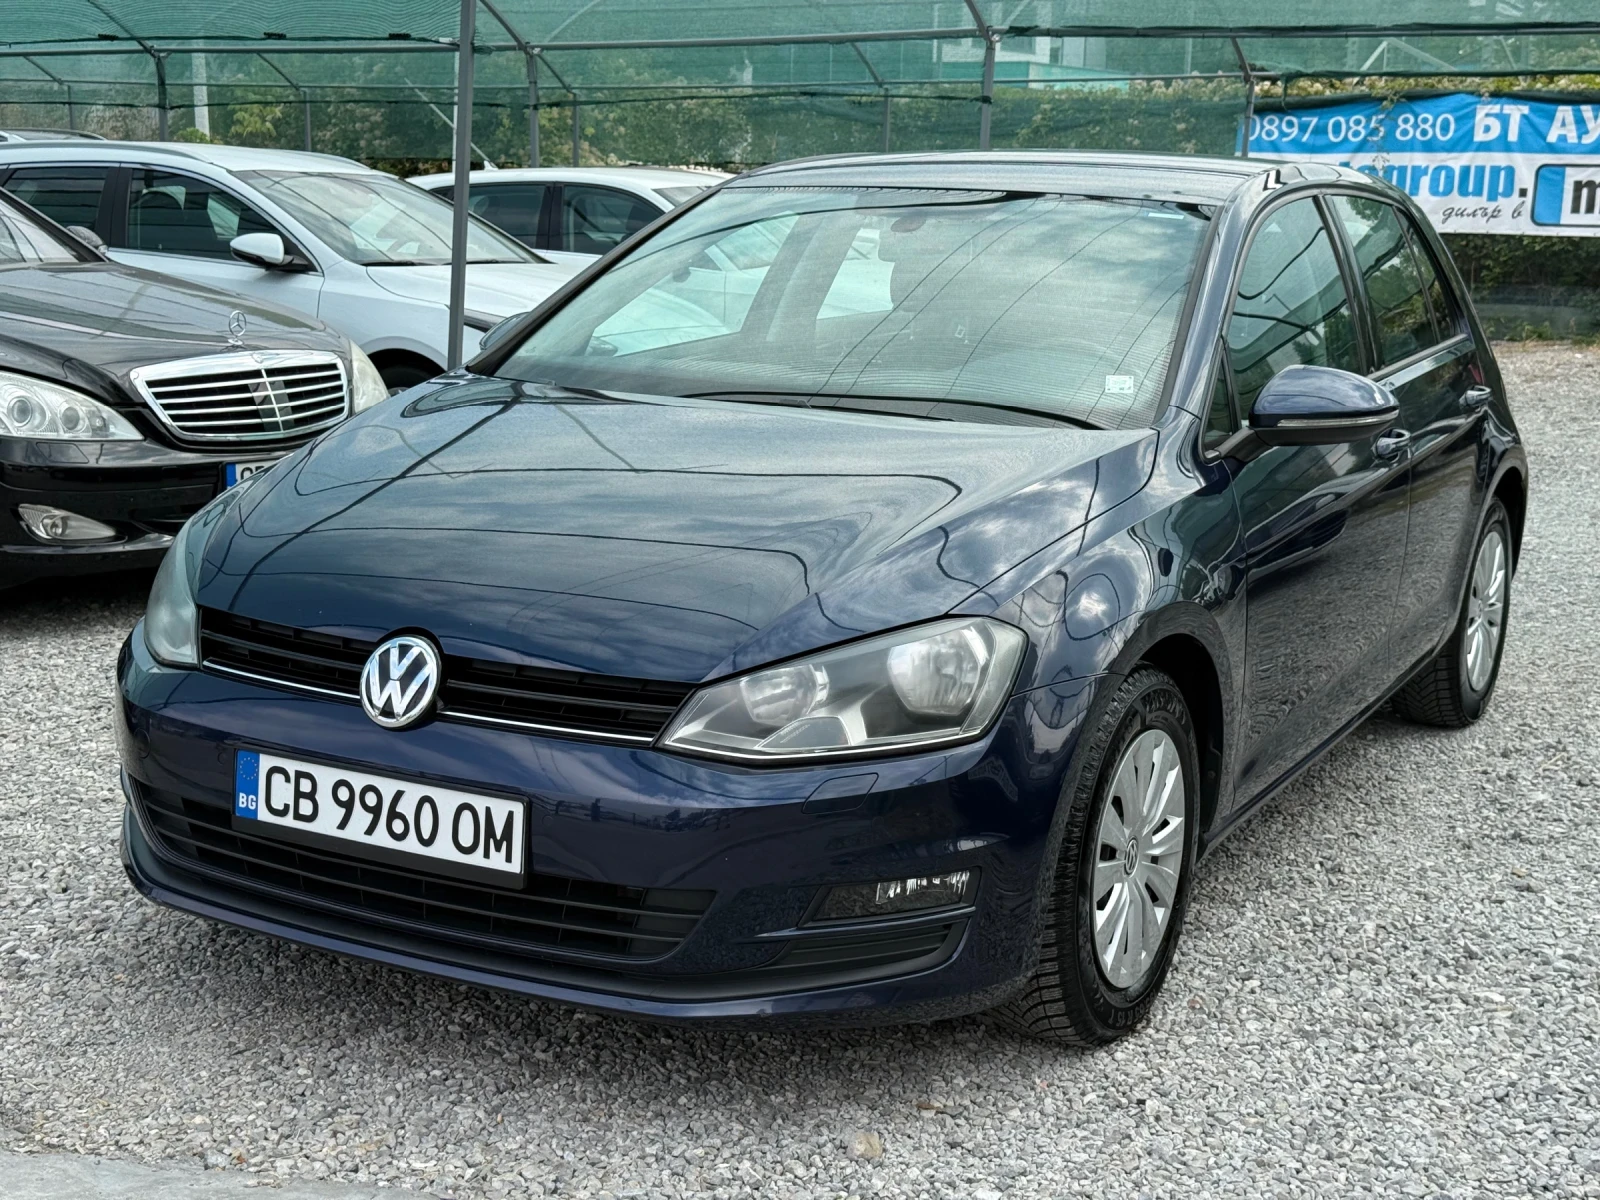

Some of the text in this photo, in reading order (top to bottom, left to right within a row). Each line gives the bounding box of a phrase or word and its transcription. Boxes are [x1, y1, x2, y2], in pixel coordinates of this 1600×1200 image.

[1242, 113, 1455, 142] 0897 085 880
[1473, 104, 1529, 142] БТ
[238, 792, 257, 810] BG
[265, 765, 515, 864] CB 9960 OM
